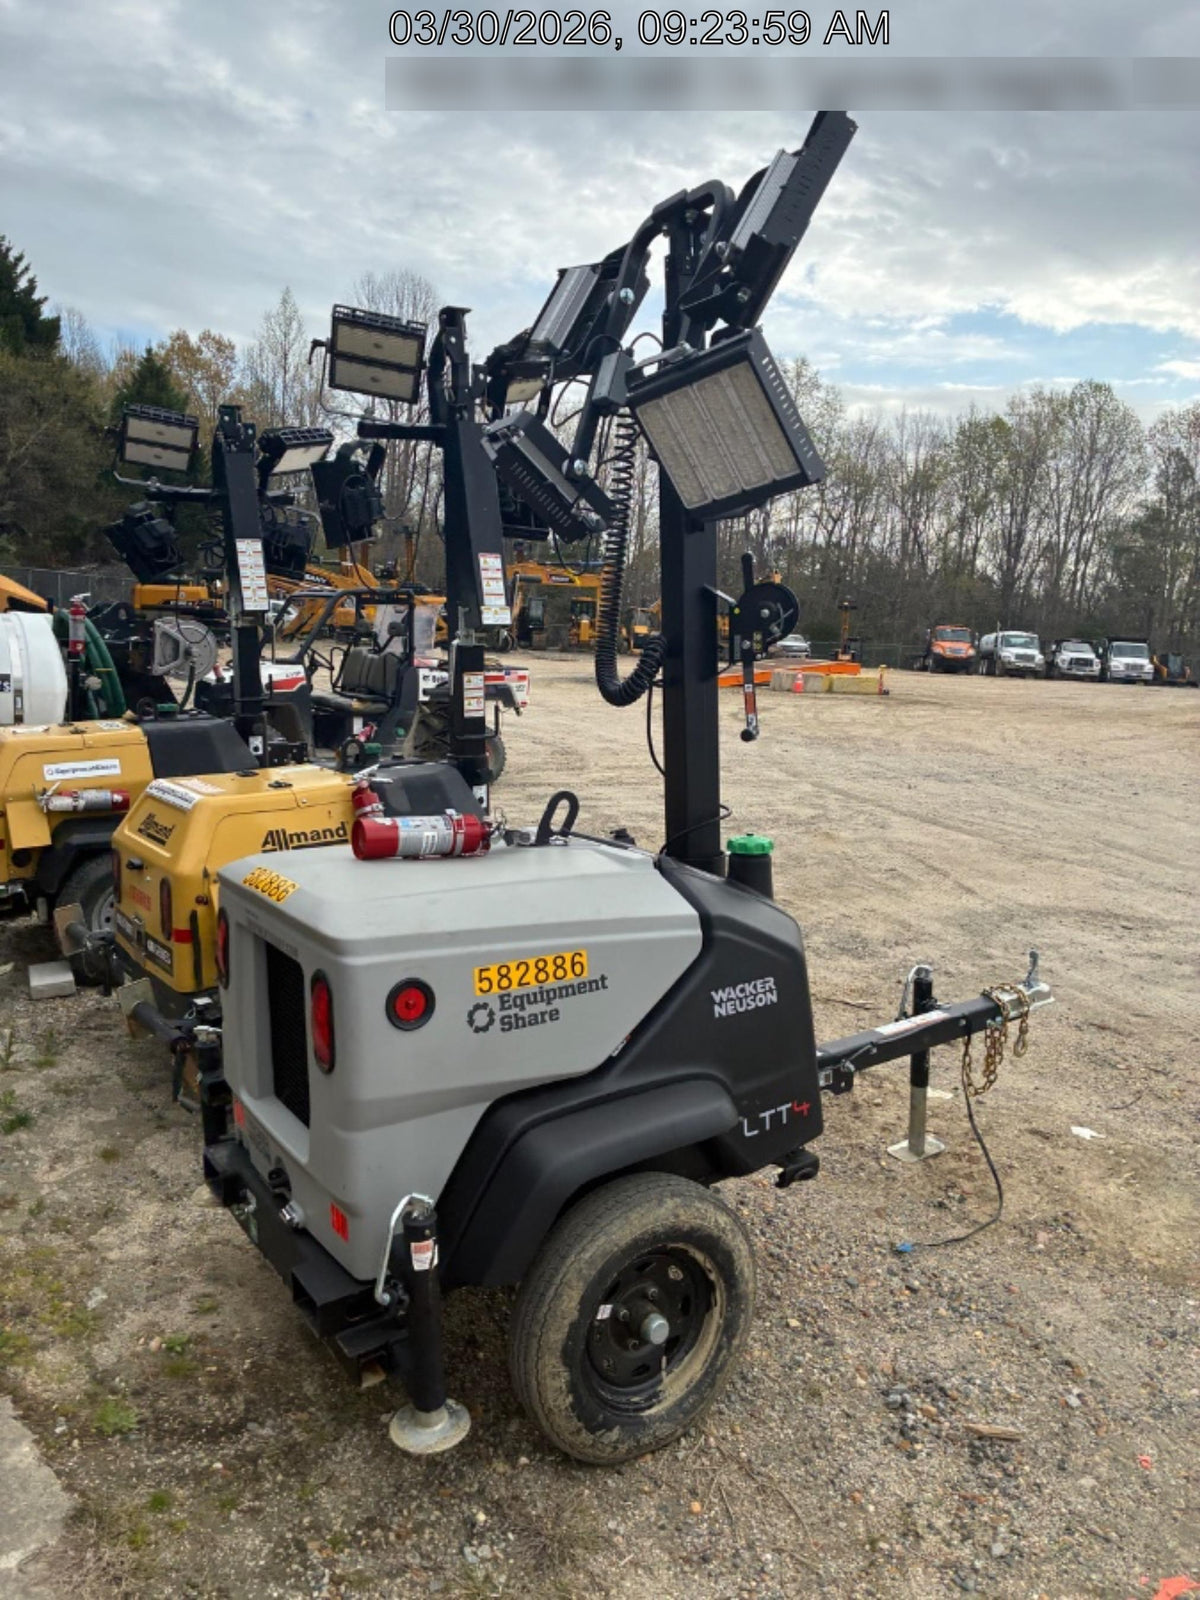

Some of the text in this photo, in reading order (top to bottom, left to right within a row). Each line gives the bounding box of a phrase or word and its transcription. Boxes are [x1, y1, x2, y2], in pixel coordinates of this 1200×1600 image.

[261, 821, 348, 852] Allmand
[477, 951, 586, 994] 582886
[498, 973, 608, 1010] Equipment
[710, 976, 777, 1004] WACKER
[713, 989, 779, 1019] NEUSON
[499, 1007, 561, 1033] Share
[742, 1100, 811, 1138] LTT4
